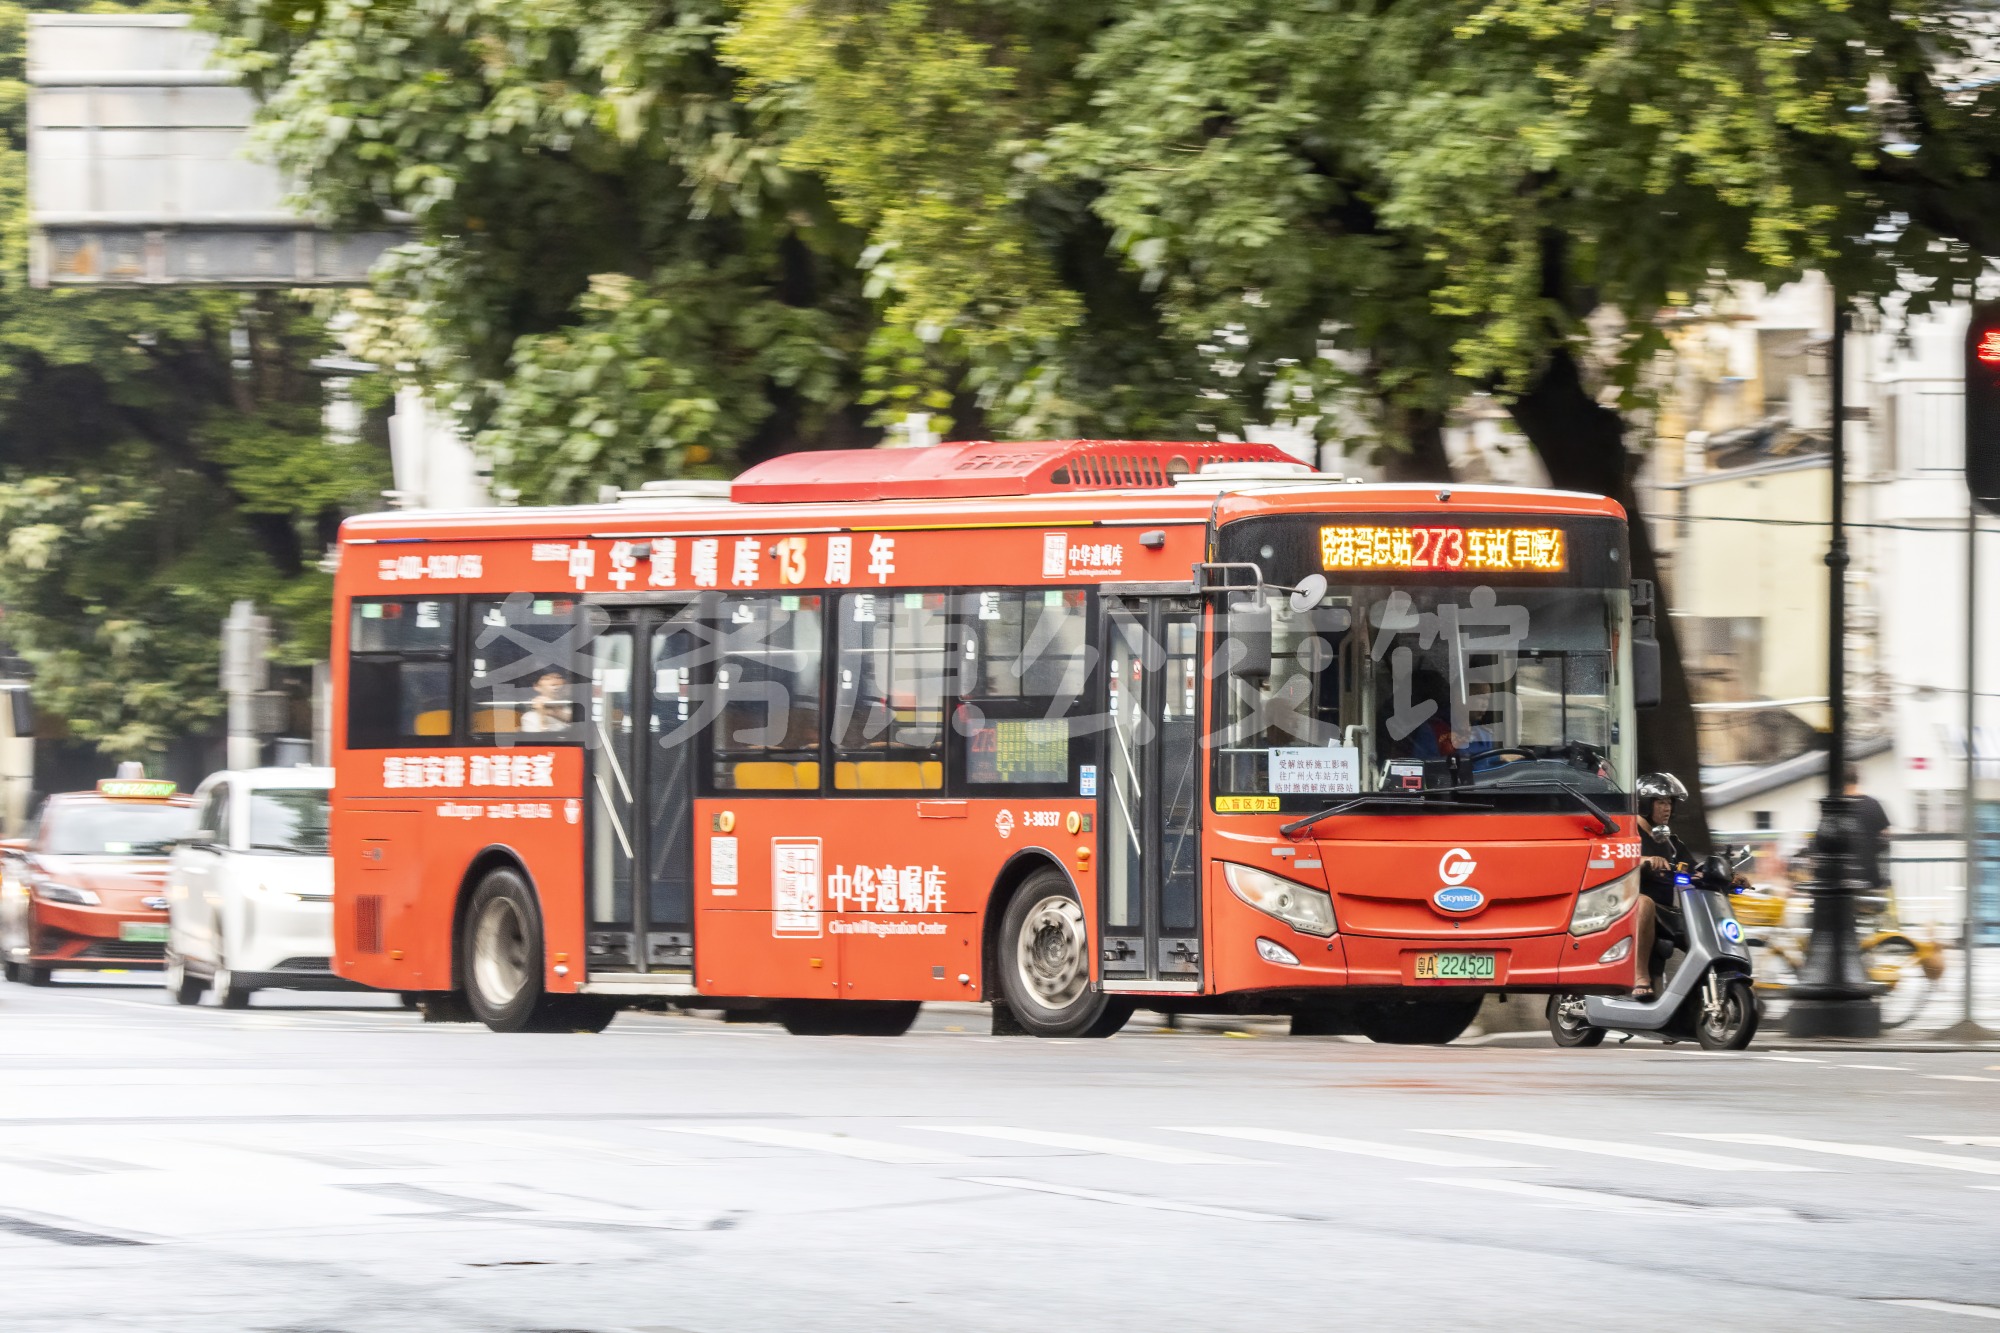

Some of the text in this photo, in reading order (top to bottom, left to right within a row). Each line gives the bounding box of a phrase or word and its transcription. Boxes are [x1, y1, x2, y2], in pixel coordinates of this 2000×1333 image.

[1411, 527, 1464, 567] 273
[1068, 544, 1123, 566] 中华遗嘱库
[971, 728, 997, 752] 273
[1279, 760, 1349, 769] 受解放桥施工影响
[1279, 772, 1349, 781] 往广州火车站方向
[1274, 783, 1353, 793] 临时撤销解放南路站
[1231, 798, 1277, 810] 盲区勿近
[1023, 811, 1060, 826] 3-38337
[827, 864, 947, 913] 中华遗嘱库
